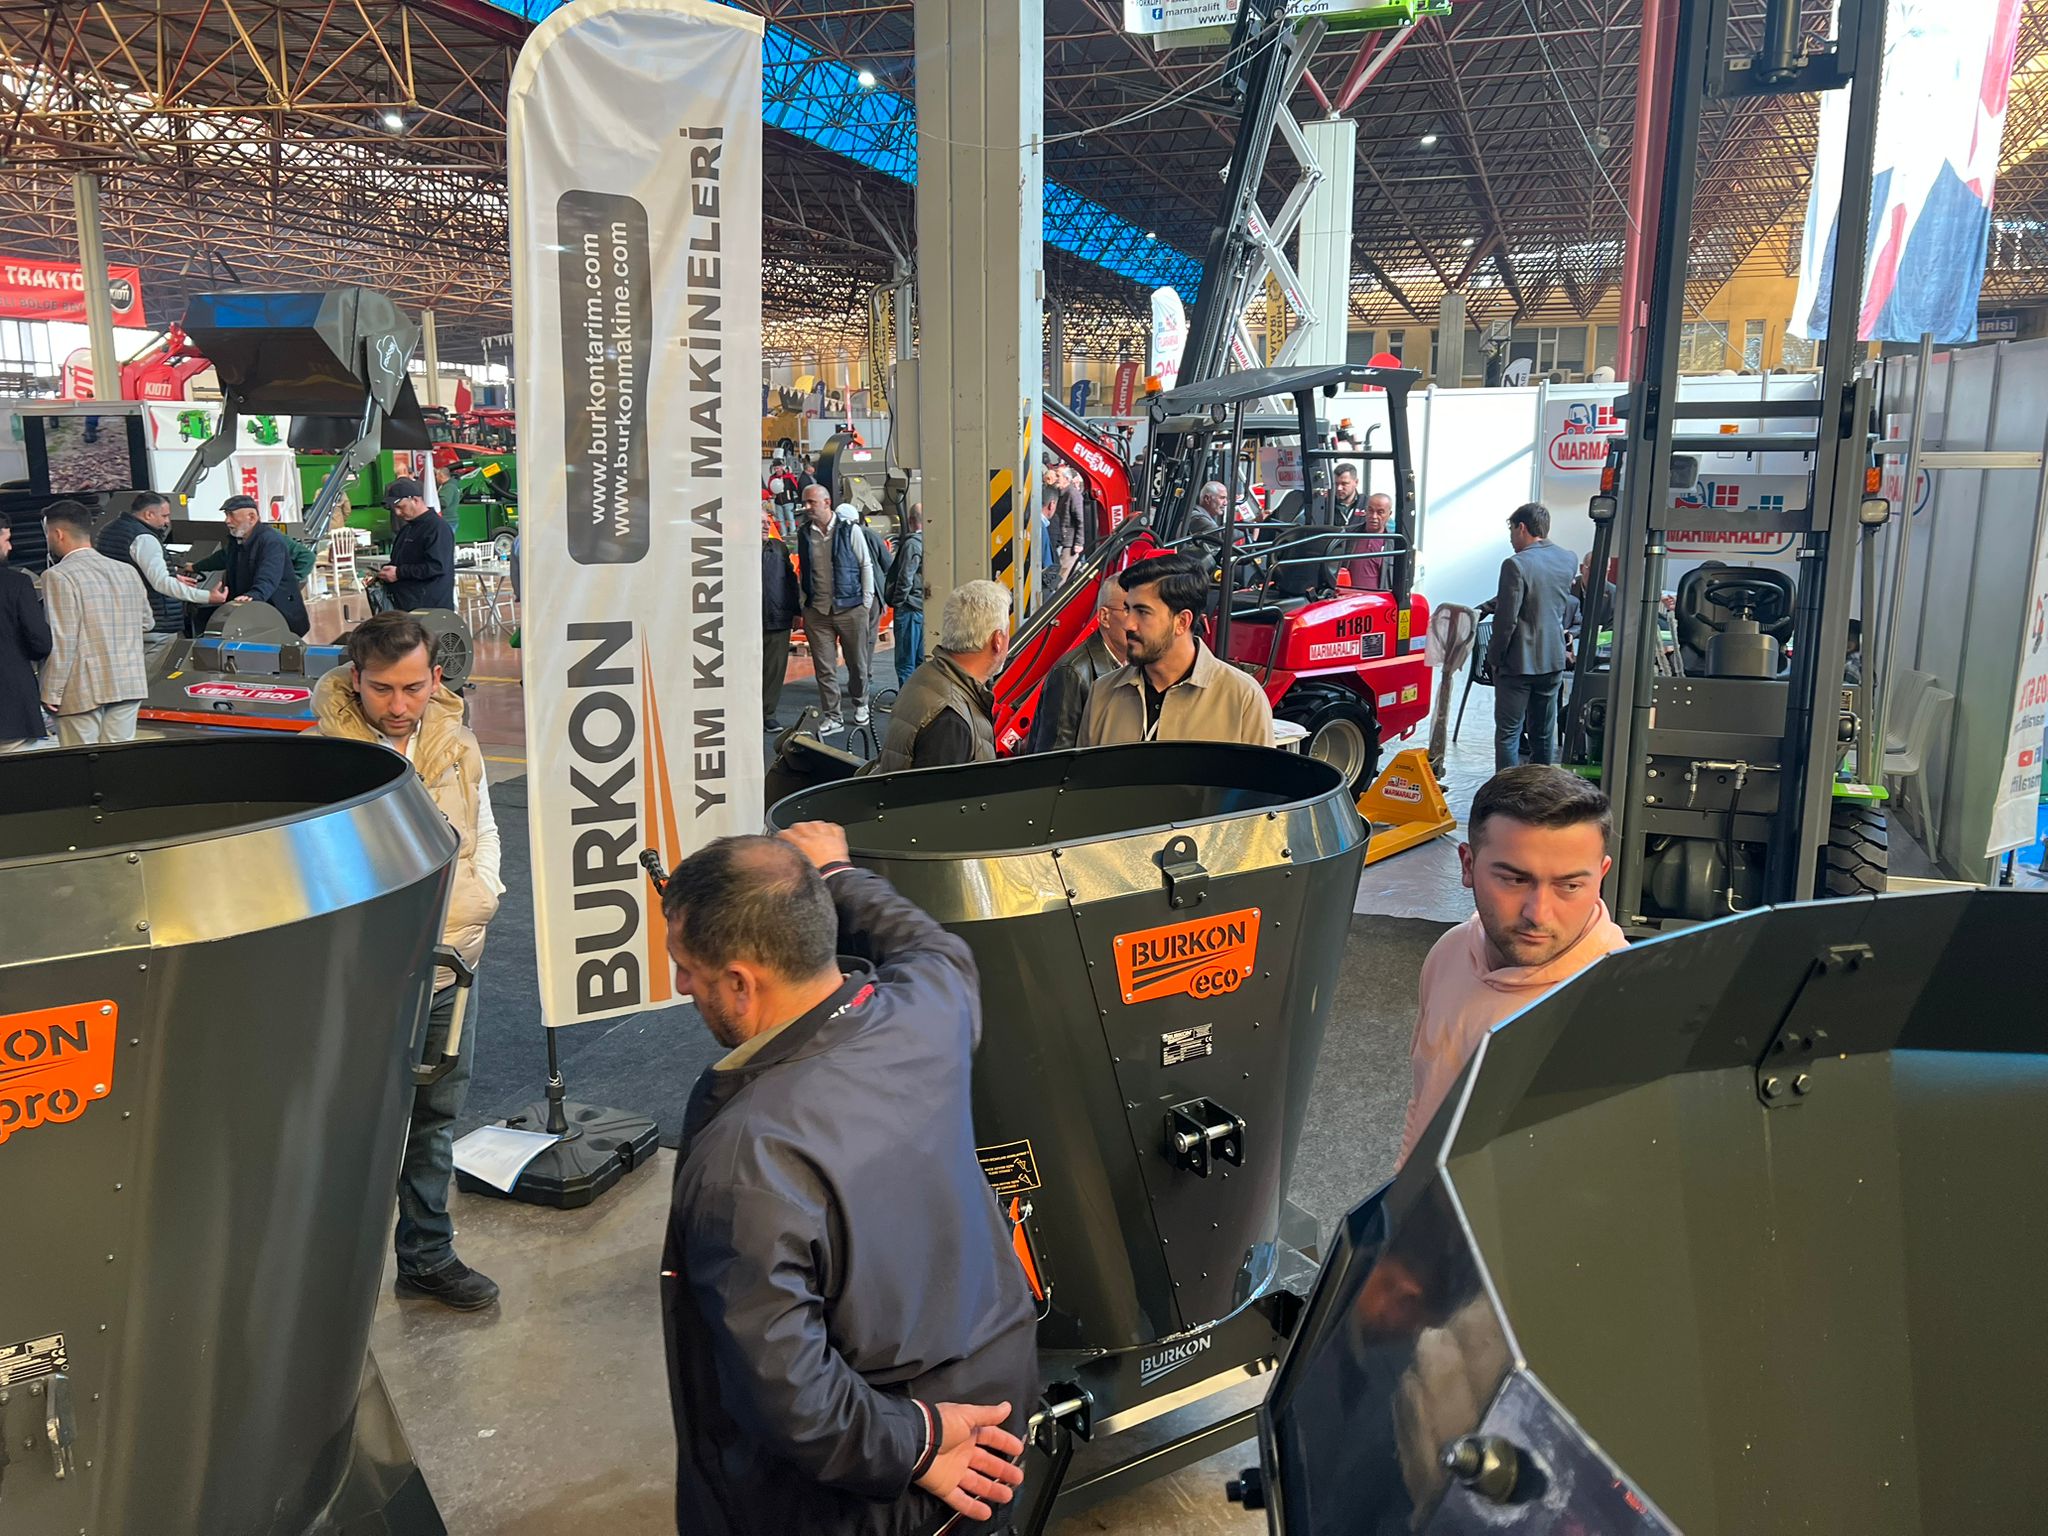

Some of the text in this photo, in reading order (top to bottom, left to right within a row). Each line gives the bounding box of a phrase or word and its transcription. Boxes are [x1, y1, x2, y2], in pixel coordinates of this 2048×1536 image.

[1166, 4, 1220, 17] marmaralift
[583, 233, 607, 524] www.burkontarim.com
[610, 221, 633, 537] www.burkonmakine.com
[679, 126, 727, 819] YEM KARMA MAKİNELERİ
[1336, 615, 1373, 638] H180
[1310, 641, 1359, 659] MARMARALIFT
[254, 691, 295, 700] 1500
[1384, 787, 1421, 800] MARMARALIFT
[566, 620, 640, 1015] BURKON
[1131, 921, 1246, 968] BURKON
[1195, 968, 1239, 994] eco
[0, 1020, 89, 1066] ON
[1141, 1335, 1212, 1373] BURKON
